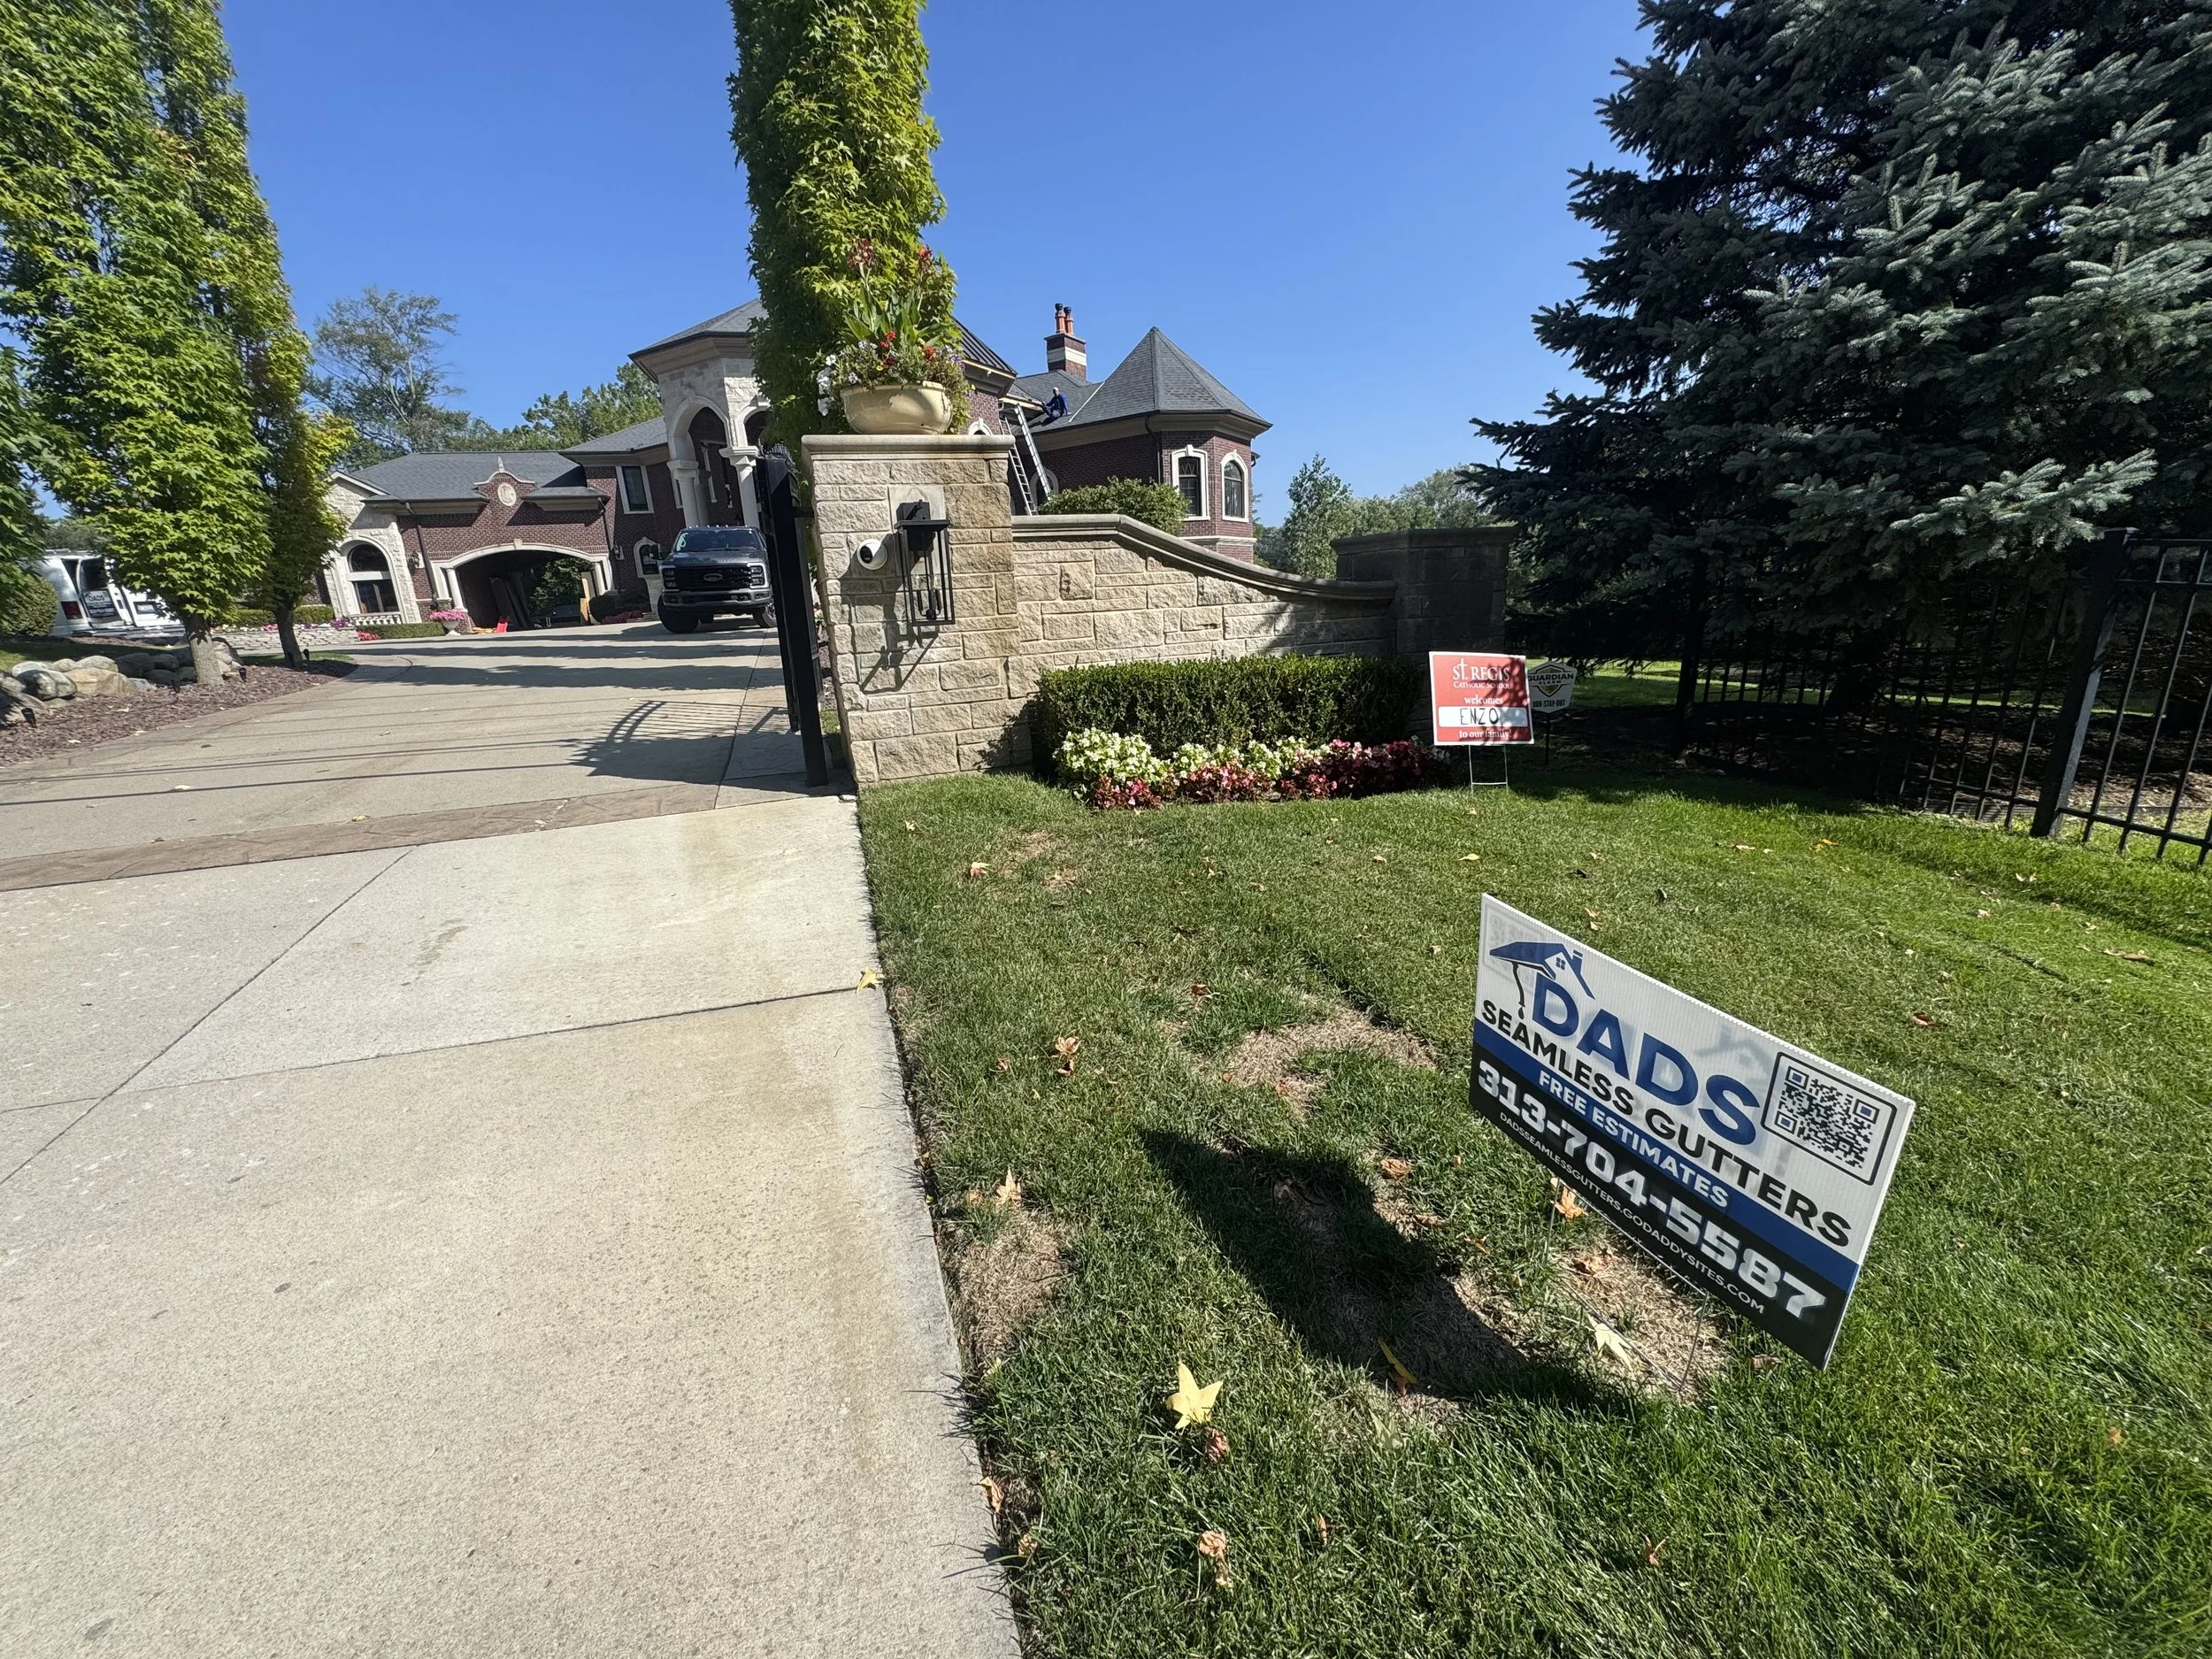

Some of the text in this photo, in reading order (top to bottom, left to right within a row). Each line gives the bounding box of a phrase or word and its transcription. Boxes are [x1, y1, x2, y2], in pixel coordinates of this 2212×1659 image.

[1459, 730, 1468, 739] to
[1460, 707, 1499, 726] ENZO
[1464, 694, 1503, 705] welcomes
[1471, 666, 1510, 681] REGIS
[1482, 1000, 1852, 1247] SEAMLESS GUTTERS
[1532, 973, 1760, 1146] DADS
[1479, 1061, 1826, 1318] 313-704-5587
[1539, 1071, 1729, 1208] FREE ESTIMATES
[1500, 1112, 1764, 1314] DADSSEAMLESSGUTTERS.GODADDYSITES.COM
